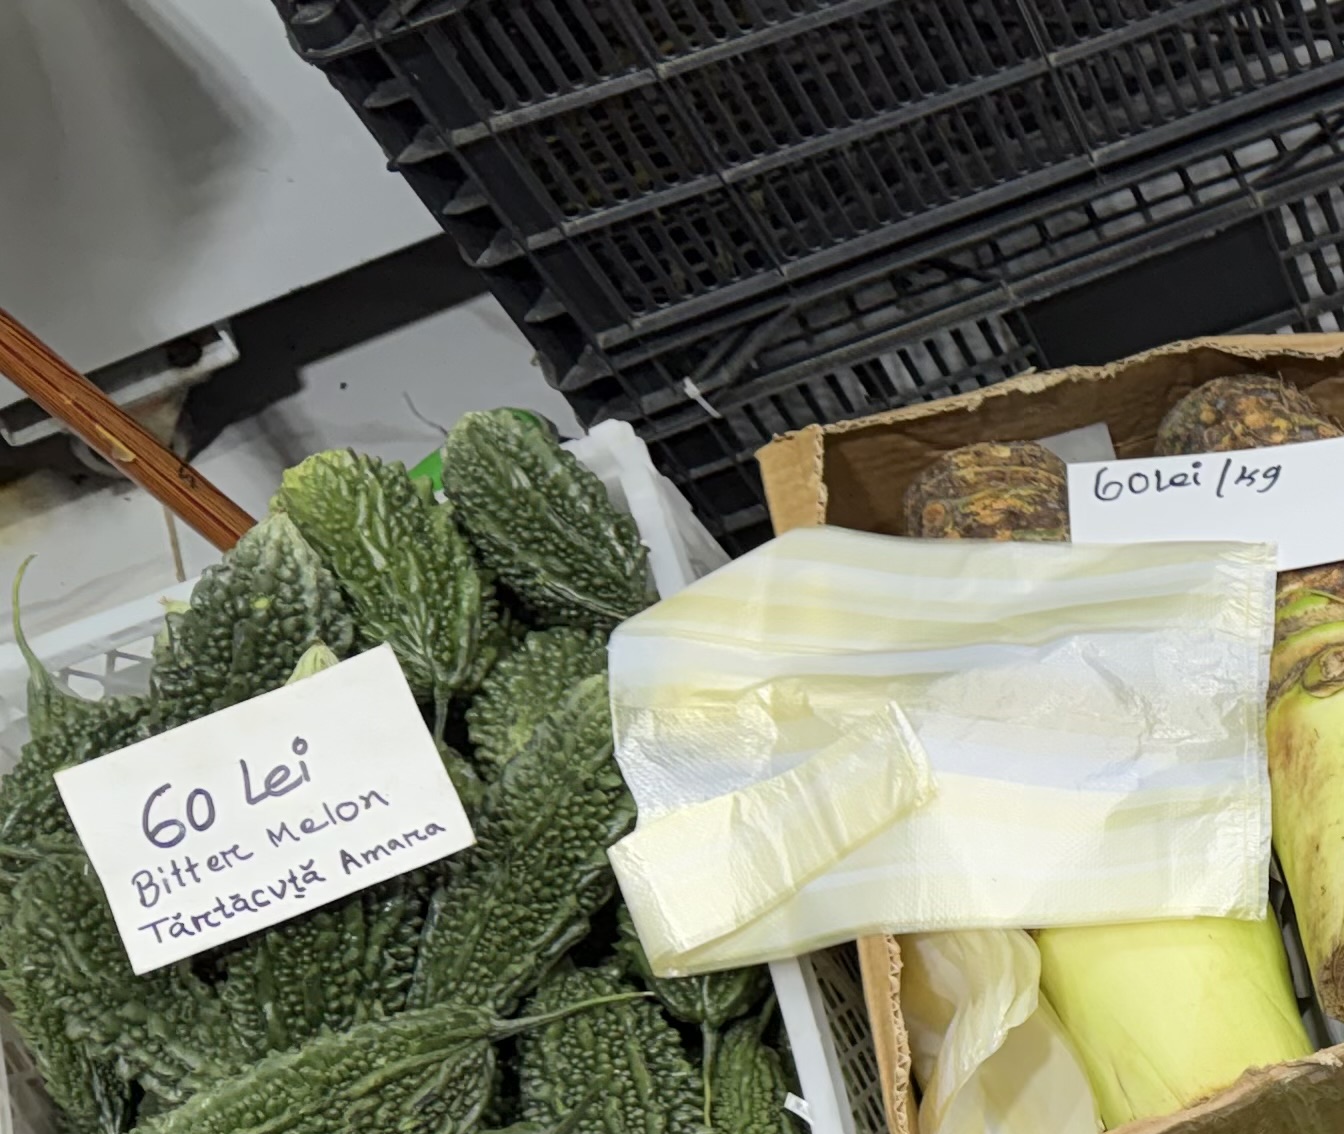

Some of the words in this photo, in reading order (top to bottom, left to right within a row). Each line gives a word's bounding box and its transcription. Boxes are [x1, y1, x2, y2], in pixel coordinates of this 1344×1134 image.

[130, 844, 254, 909] Bitter
[266, 789, 390, 848] Melon
[141, 782, 216, 849] 60
[239, 735, 311, 806] Lei
[338, 821, 447, 876] Amara
